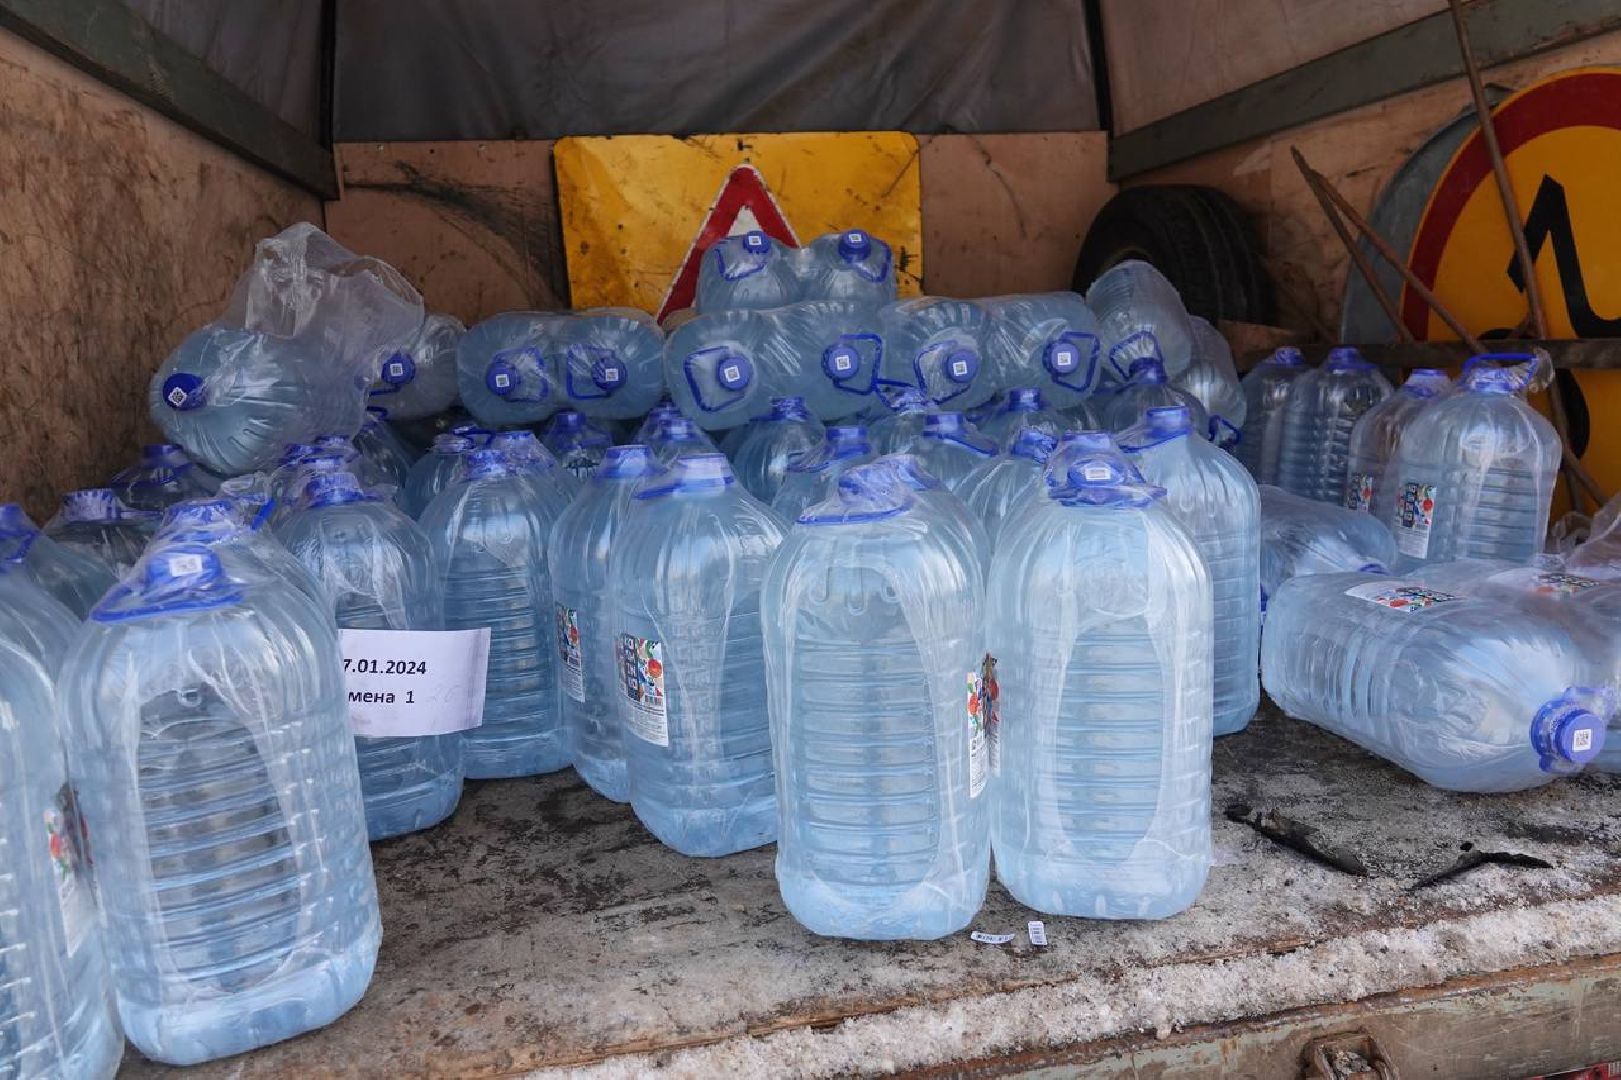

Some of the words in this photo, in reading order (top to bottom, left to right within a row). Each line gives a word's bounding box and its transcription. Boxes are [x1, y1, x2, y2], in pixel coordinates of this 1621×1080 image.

[343, 658, 427, 675] 7.01.2024
[348, 690, 396, 704] мена
[405, 690, 415, 704] 1
